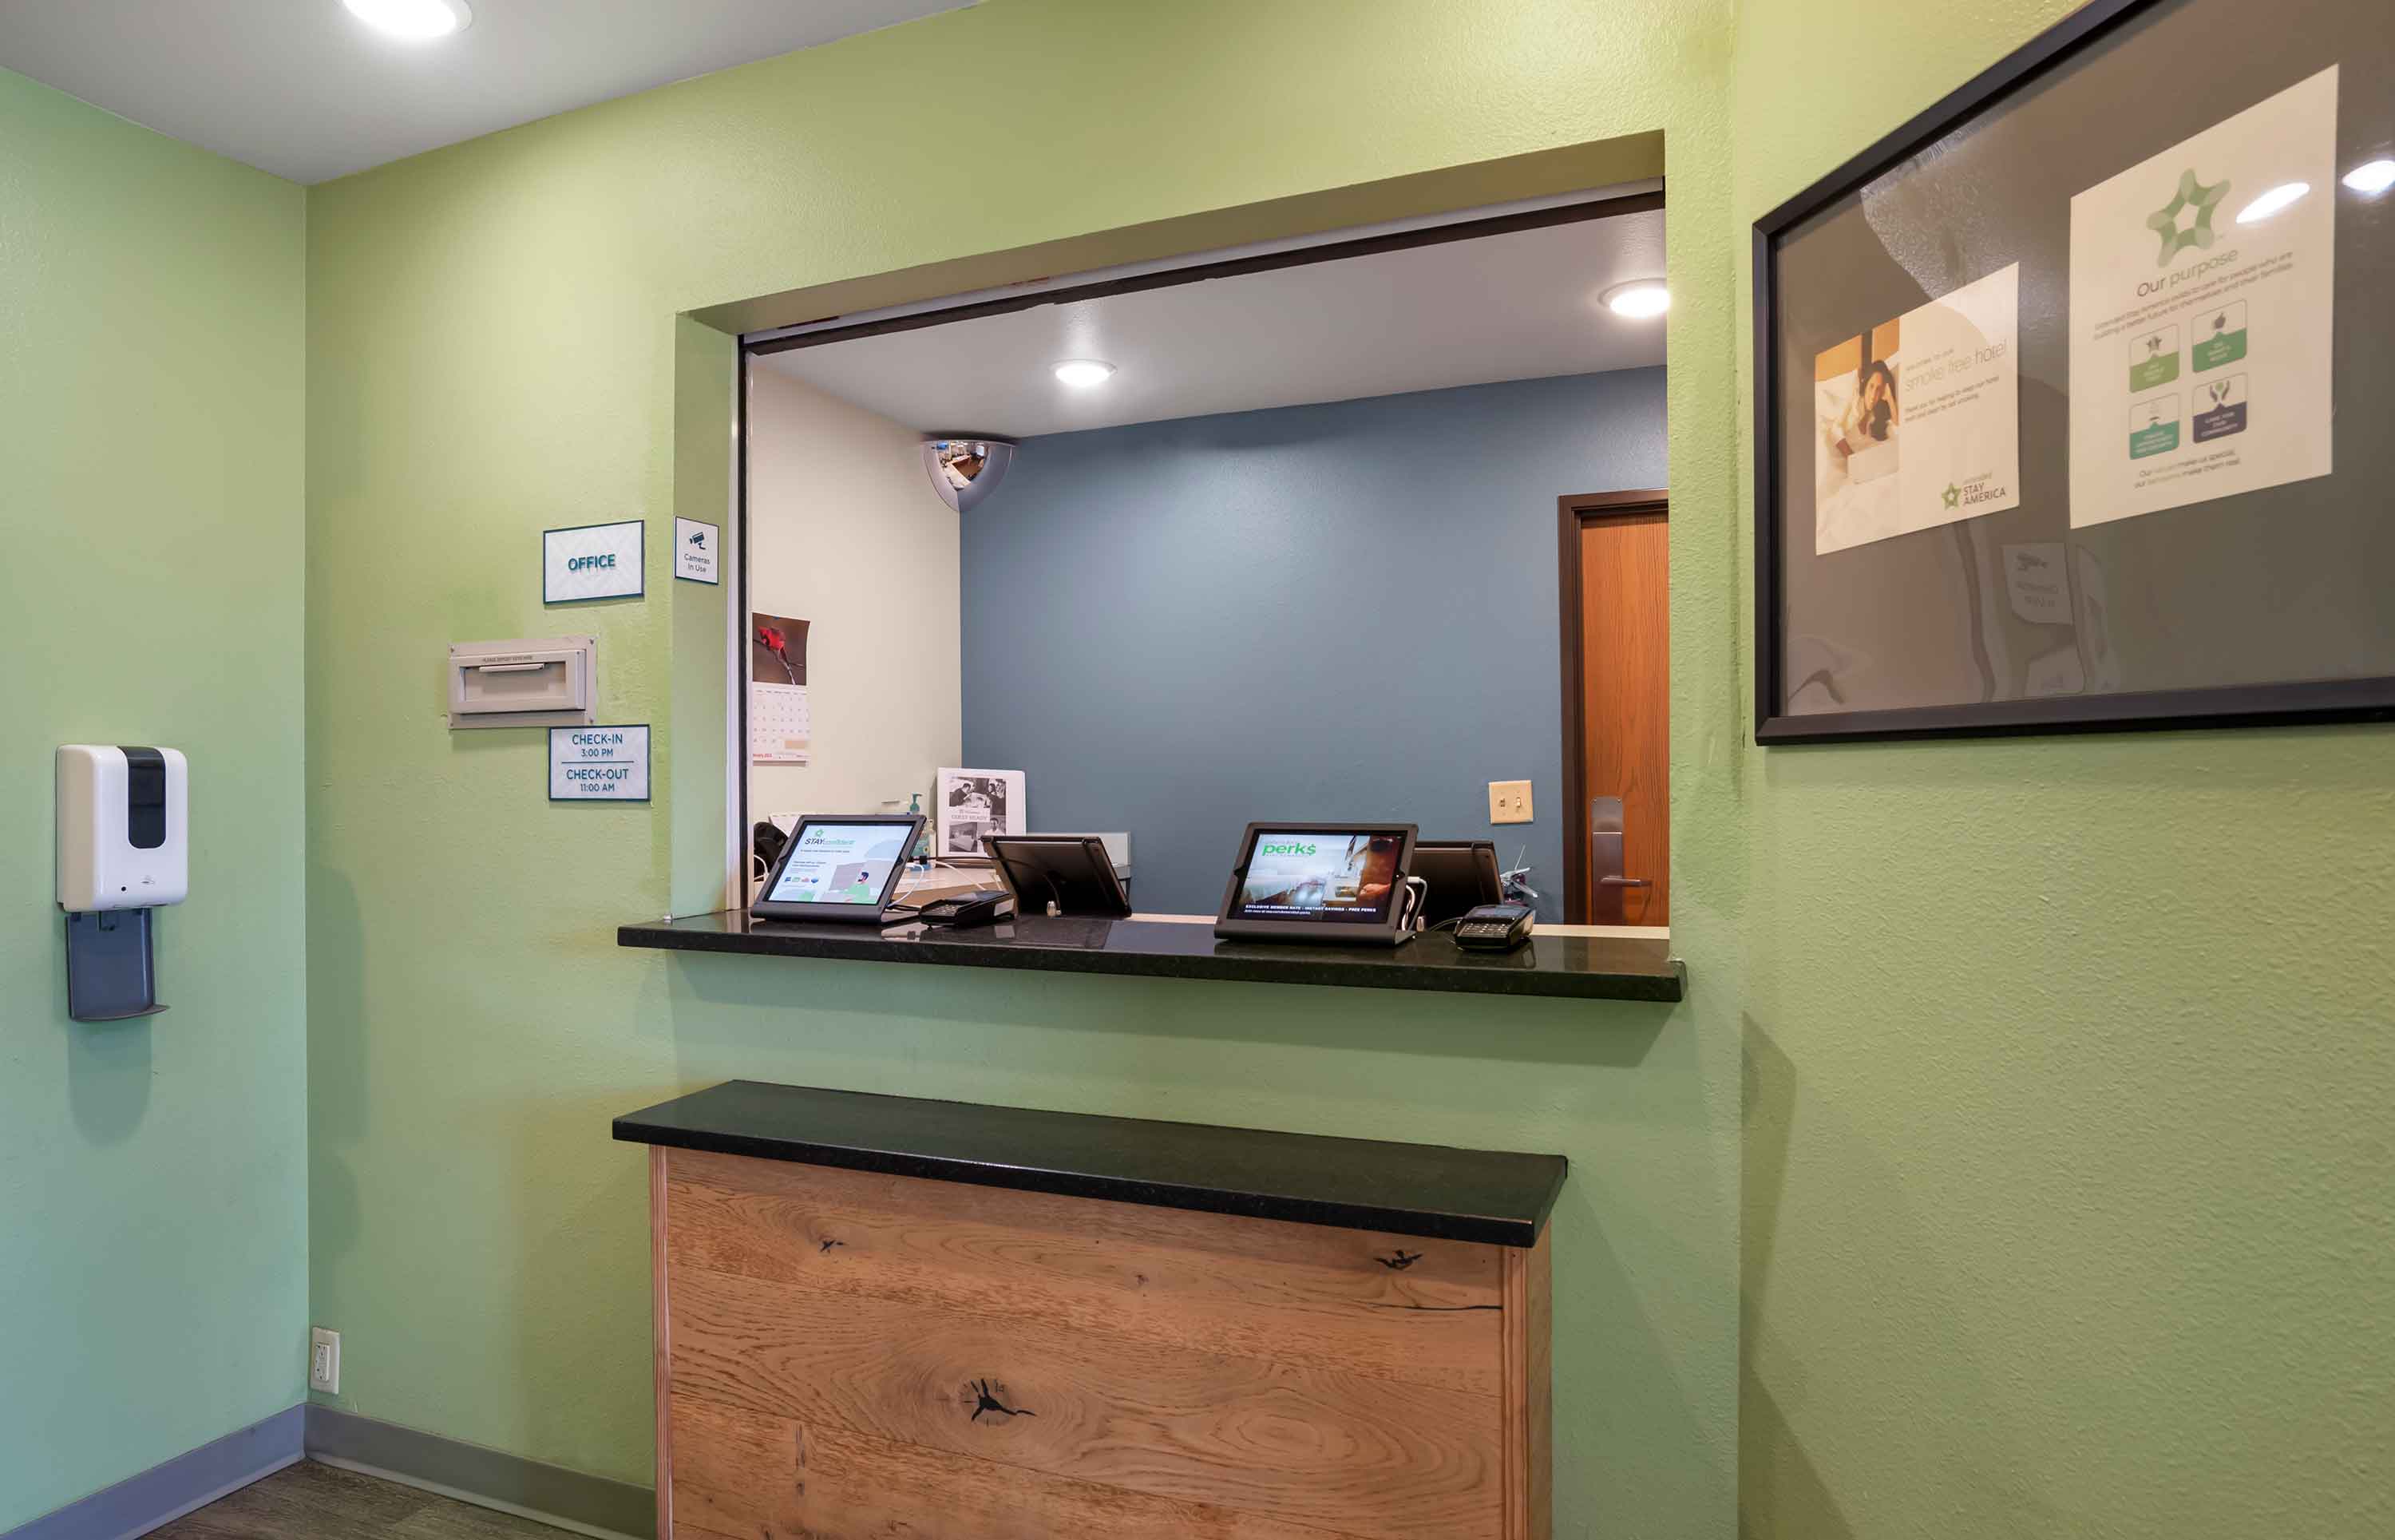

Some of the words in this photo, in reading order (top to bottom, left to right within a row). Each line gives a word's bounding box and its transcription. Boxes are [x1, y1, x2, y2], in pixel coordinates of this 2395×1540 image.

[2136, 276, 2166, 298] Our
[2169, 249, 2239, 288] purpose
[1974, 338, 2006, 365] hotel
[1963, 481, 1985, 497] STAY
[1963, 487, 2007, 507] AMERICA
[568, 553, 616, 572] OFFICE
[684, 552, 711, 566] Cameras
[695, 564, 707, 574] Use
[572, 734, 623, 746] CHECK-IN
[580, 748, 600, 758] 3:00
[601, 748, 614, 758] PM
[566, 768, 629, 780] CHECK-OUT
[580, 783, 600, 793] 11:00
[601, 783, 616, 793] AM
